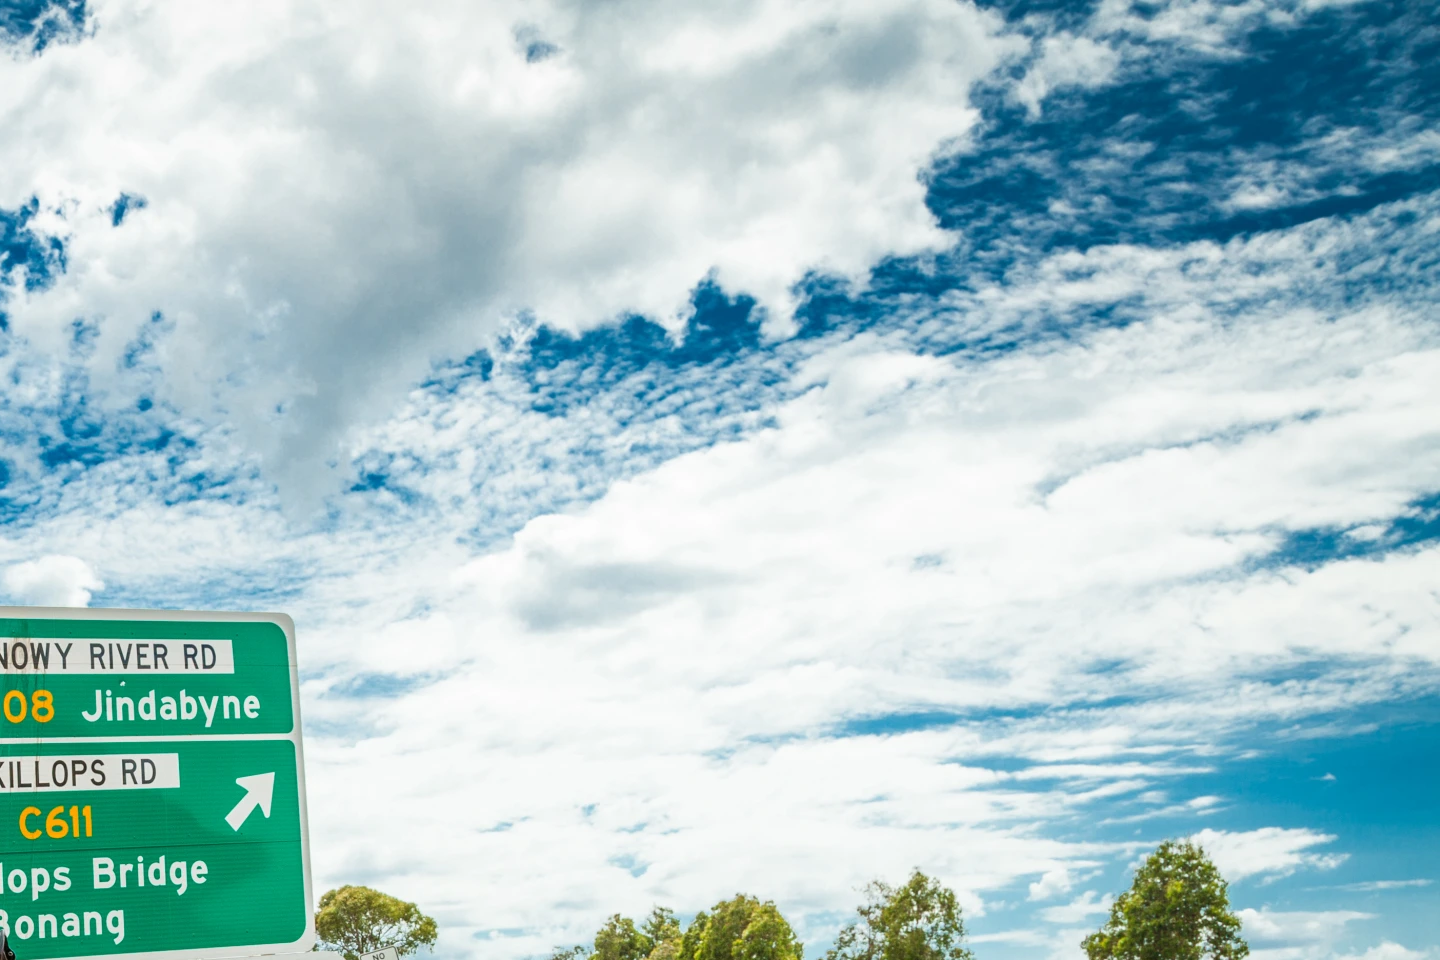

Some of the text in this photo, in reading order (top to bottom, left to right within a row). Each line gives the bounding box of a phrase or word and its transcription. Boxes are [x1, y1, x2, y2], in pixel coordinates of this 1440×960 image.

[90, 642, 169, 670] RIVER
[184, 644, 217, 670] RD
[81, 688, 260, 727] Jindabyne
[122, 758, 157, 785] RD
[19, 805, 93, 840] C611
[92, 855, 209, 896] Bridge
[372, 952, 385, 960] NO
